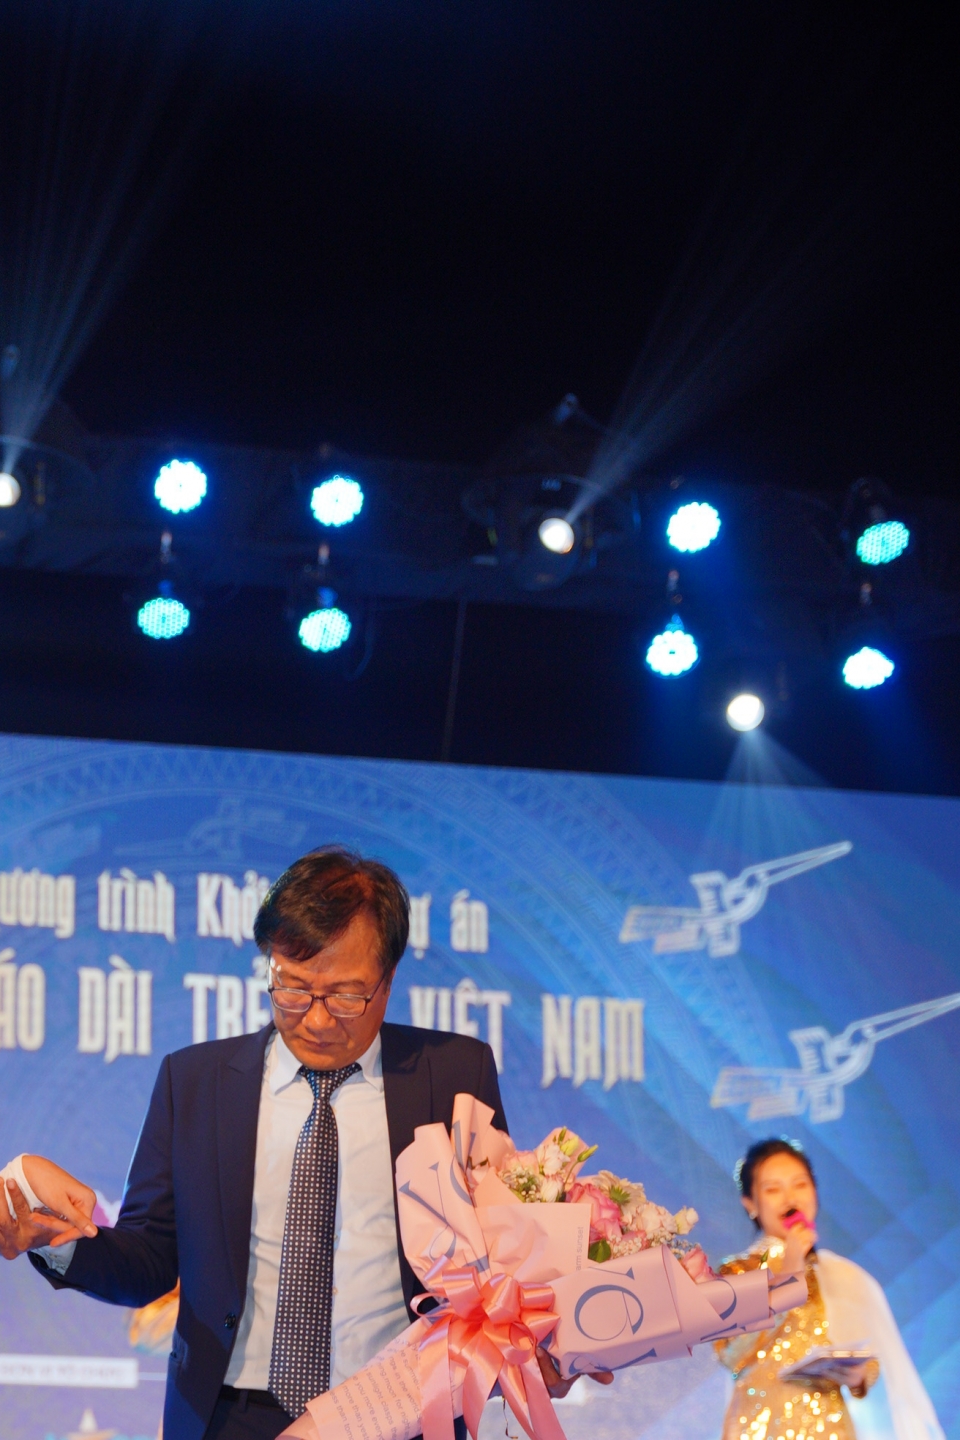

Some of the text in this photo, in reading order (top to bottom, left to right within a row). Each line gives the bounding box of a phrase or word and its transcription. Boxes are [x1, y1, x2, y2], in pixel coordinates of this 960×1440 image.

[97, 866, 176, 943] trình
[450, 888, 490, 954] án
[77, 954, 154, 1065] DÀI
[541, 992, 645, 1092] NAM
